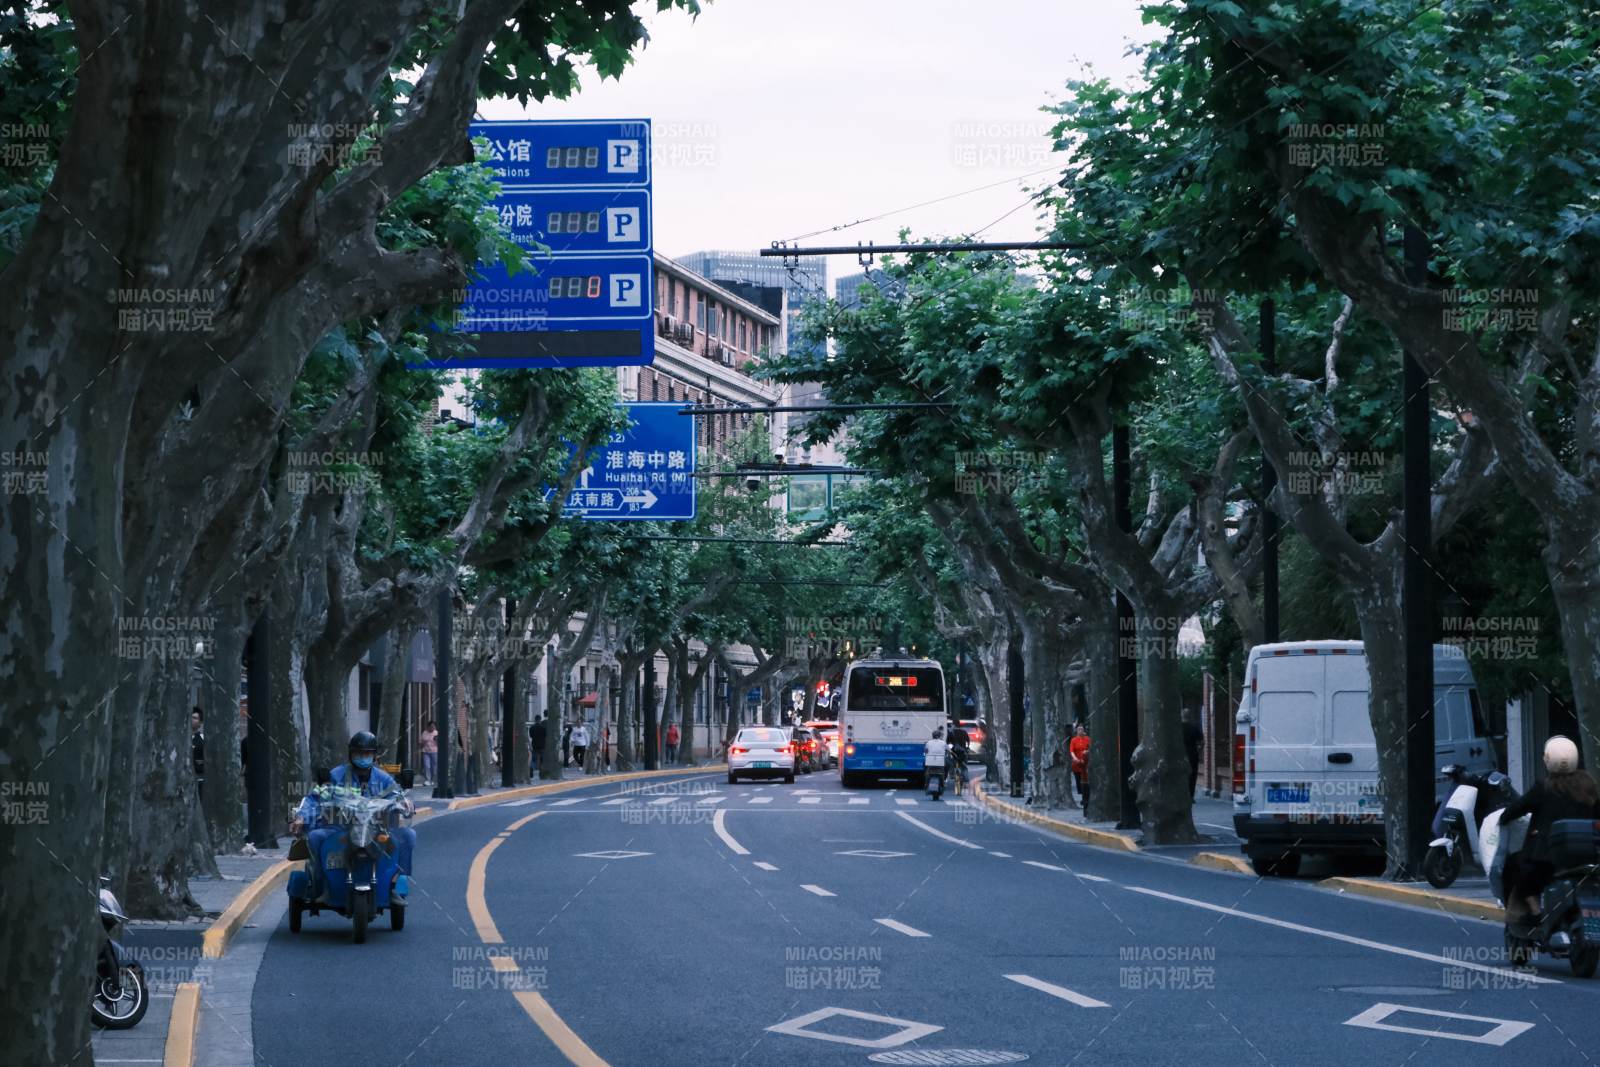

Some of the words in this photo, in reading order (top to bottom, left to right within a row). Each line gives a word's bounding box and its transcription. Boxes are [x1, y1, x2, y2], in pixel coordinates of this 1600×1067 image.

[614, 144, 632, 168] P
[614, 213, 633, 237] P
[615, 278, 634, 302] P
[605, 449, 687, 470] 淮海中路
[605, 472, 646, 482] Huaihai
[671, 472, 687, 482] (M)
[564, 492, 615, 507] 庆南路
